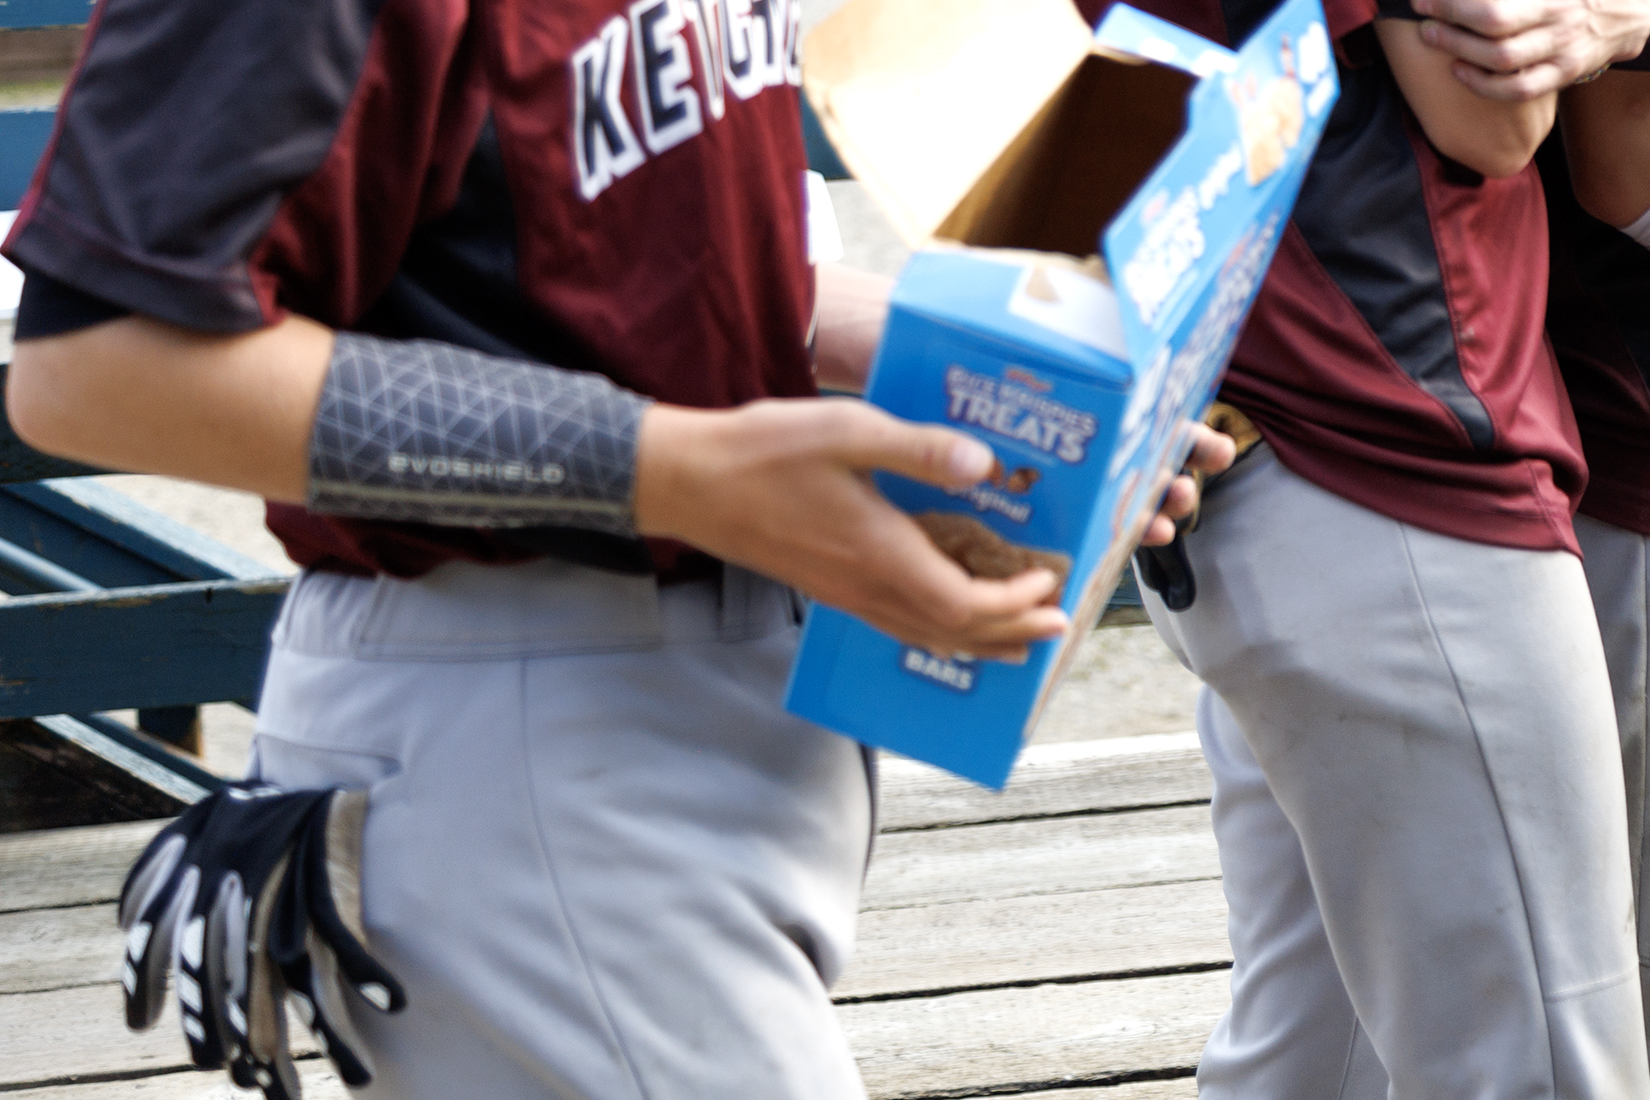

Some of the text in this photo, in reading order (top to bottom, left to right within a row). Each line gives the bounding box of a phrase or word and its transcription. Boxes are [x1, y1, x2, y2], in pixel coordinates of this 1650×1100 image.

[949, 388, 1085, 464] TREATS
[948, 486, 1031, 524] riginal
[904, 648, 974, 692] BARS
